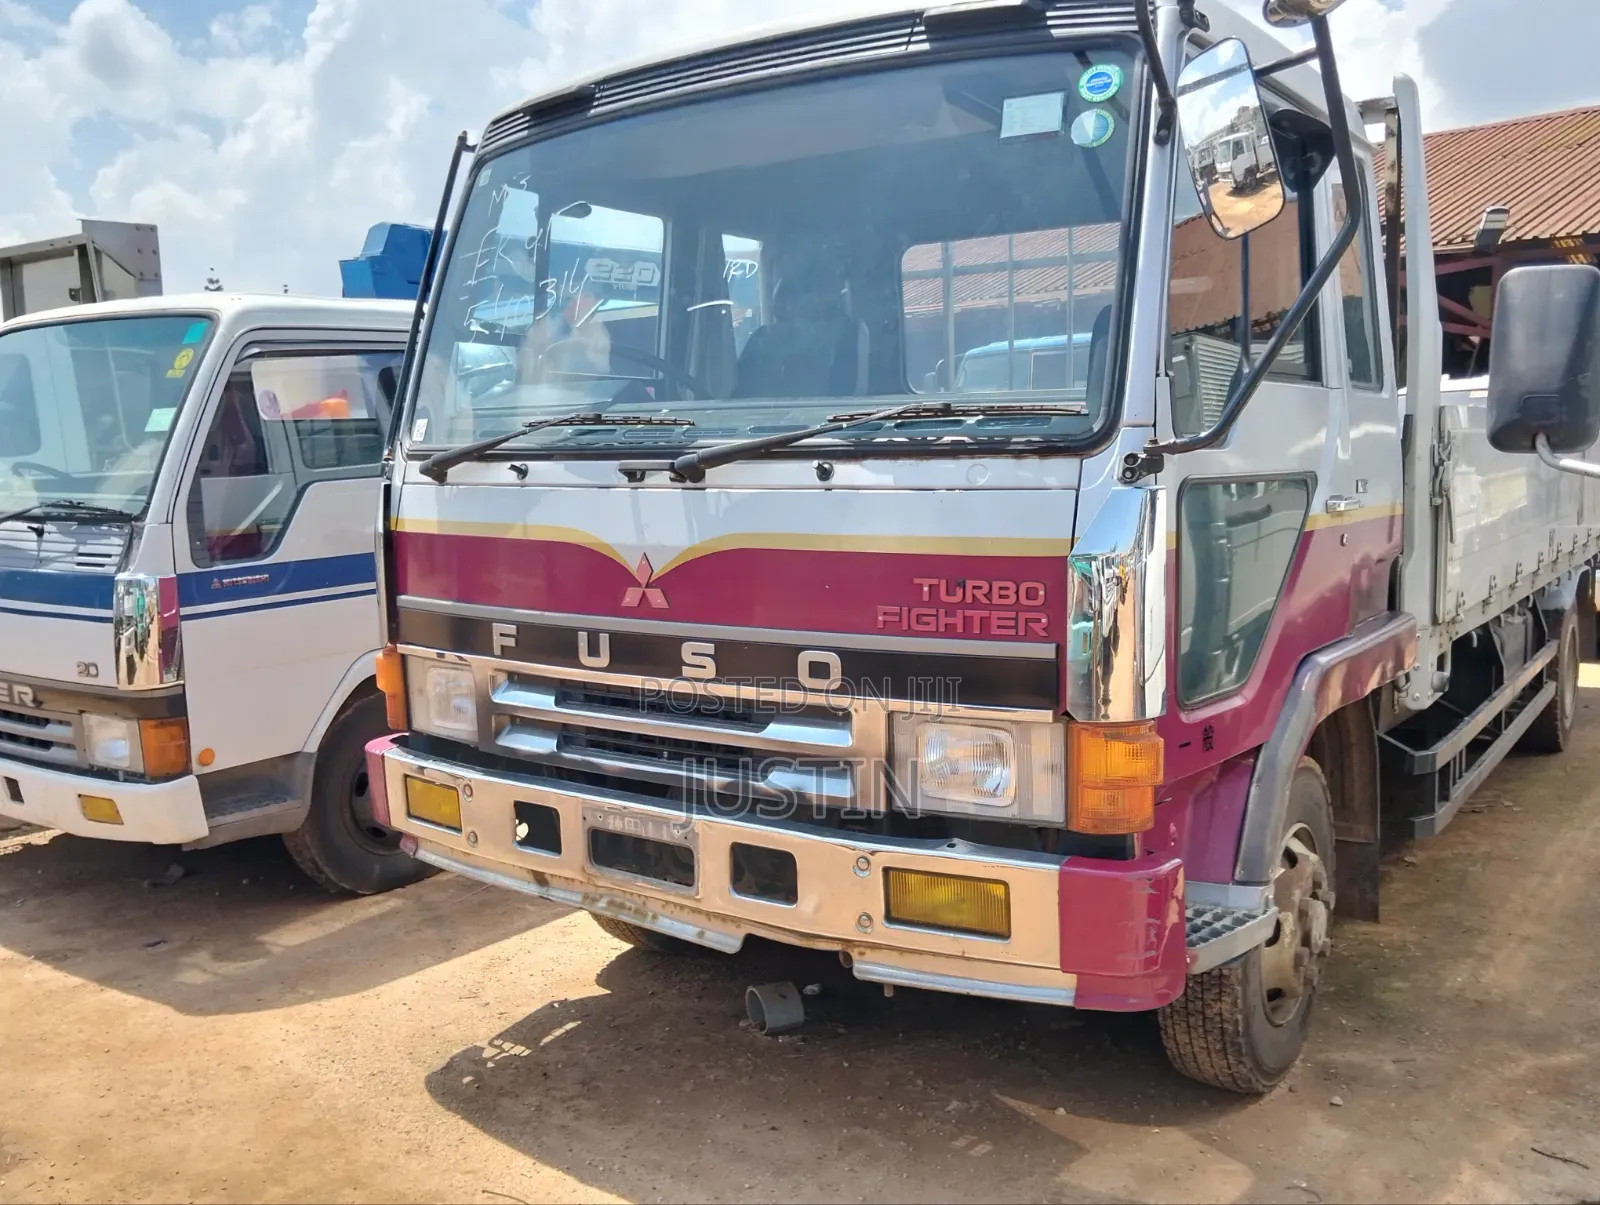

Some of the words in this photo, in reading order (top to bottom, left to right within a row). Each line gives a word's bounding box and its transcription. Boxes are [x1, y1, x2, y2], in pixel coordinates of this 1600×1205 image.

[912, 577, 1047, 606] TURBO
[876, 605, 1050, 637] FIGHTER
[491, 622, 843, 690] FUSO
